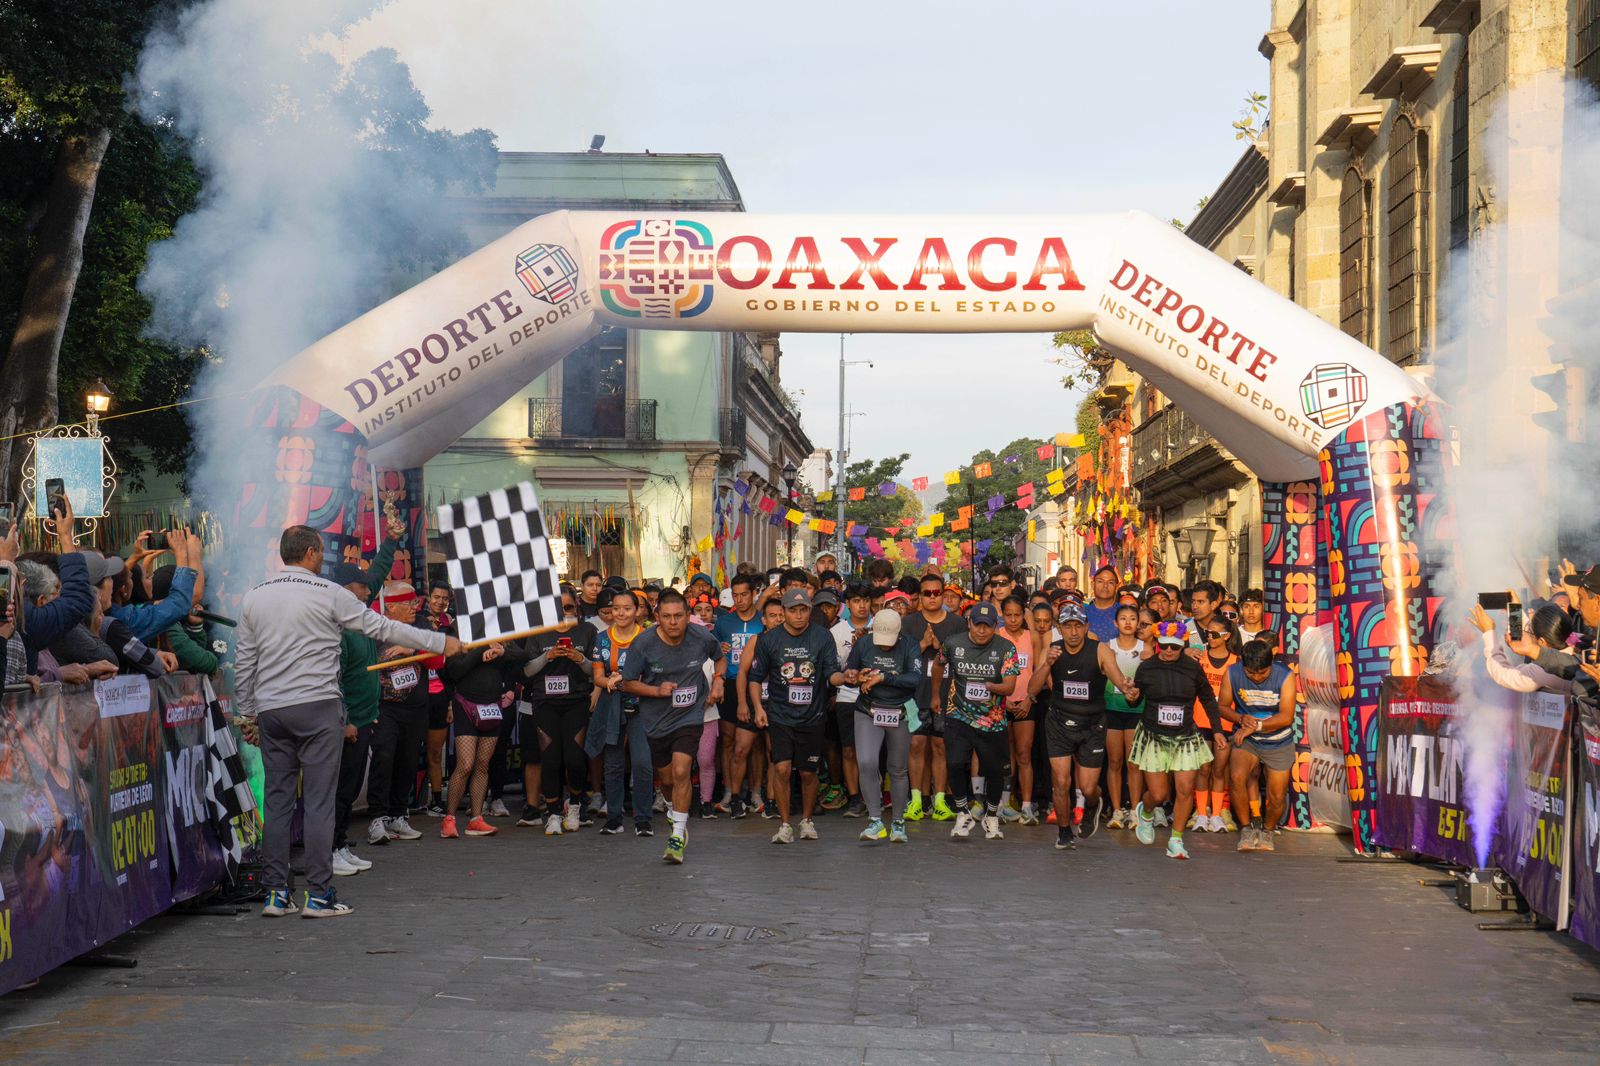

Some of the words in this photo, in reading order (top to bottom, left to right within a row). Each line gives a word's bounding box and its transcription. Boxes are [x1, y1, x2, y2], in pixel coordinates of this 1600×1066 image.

[716, 235, 1086, 292] OAXACA
[745, 299, 880, 312] GOBIERNO
[895, 300, 941, 312] DEL
[956, 301, 1057, 313] ESTADO
[1109, 259, 1278, 383] DEPORTE
[343, 289, 523, 412] DEPORTE
[364, 366, 461, 436] INSTITUTO
[468, 342, 504, 370] DEL
[509, 289, 592, 347] DEPORTE
[1098, 293, 1190, 359] INSTITUTO
[1196, 355, 1230, 387] DEL
[1236, 381, 1323, 447] DEPORTE
[957, 661, 995, 671] OAXACA
[395, 672, 416, 686] 0502
[548, 681, 568, 691] 0287
[967, 687, 989, 697] 4075
[1066, 686, 1088, 696] 0288
[675, 691, 697, 703] 0297
[791, 691, 812, 701] 0123
[481, 705, 501, 717] 3552
[1161, 711, 1182, 722] 1004
[876, 714, 898, 723] 0126
